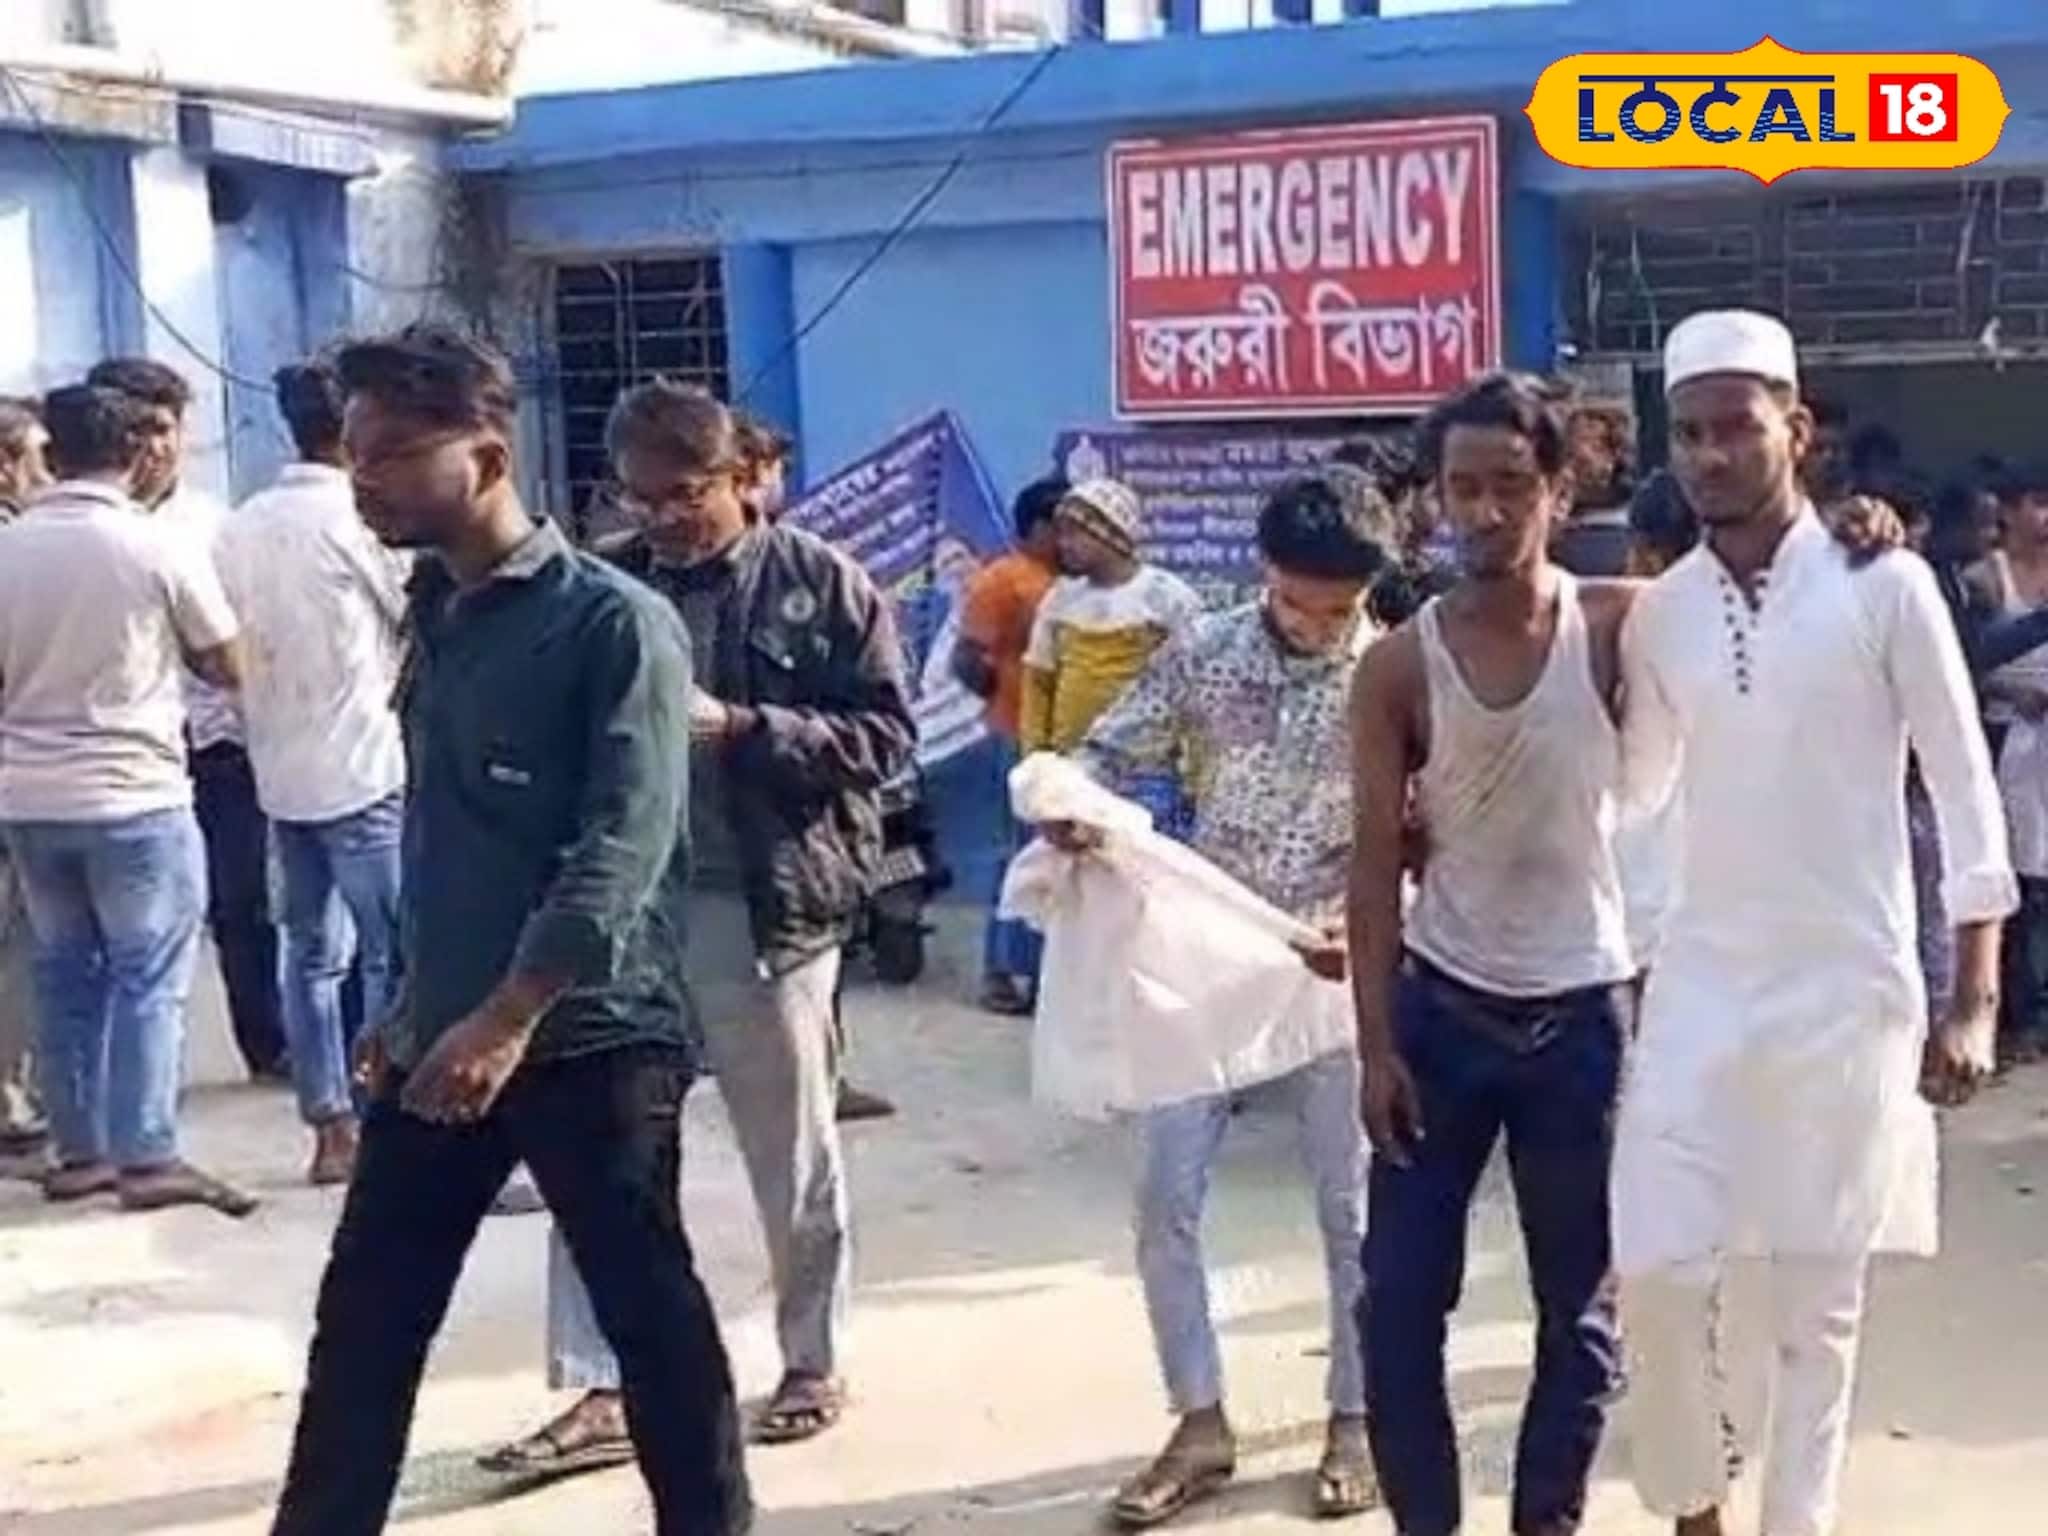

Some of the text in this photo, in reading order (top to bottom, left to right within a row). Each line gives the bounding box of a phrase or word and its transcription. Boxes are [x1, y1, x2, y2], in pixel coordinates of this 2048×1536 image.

[1129, 149, 1473, 279] EMERGENCY
[1129, 281, 1478, 394] জরুরী বিভাগ
